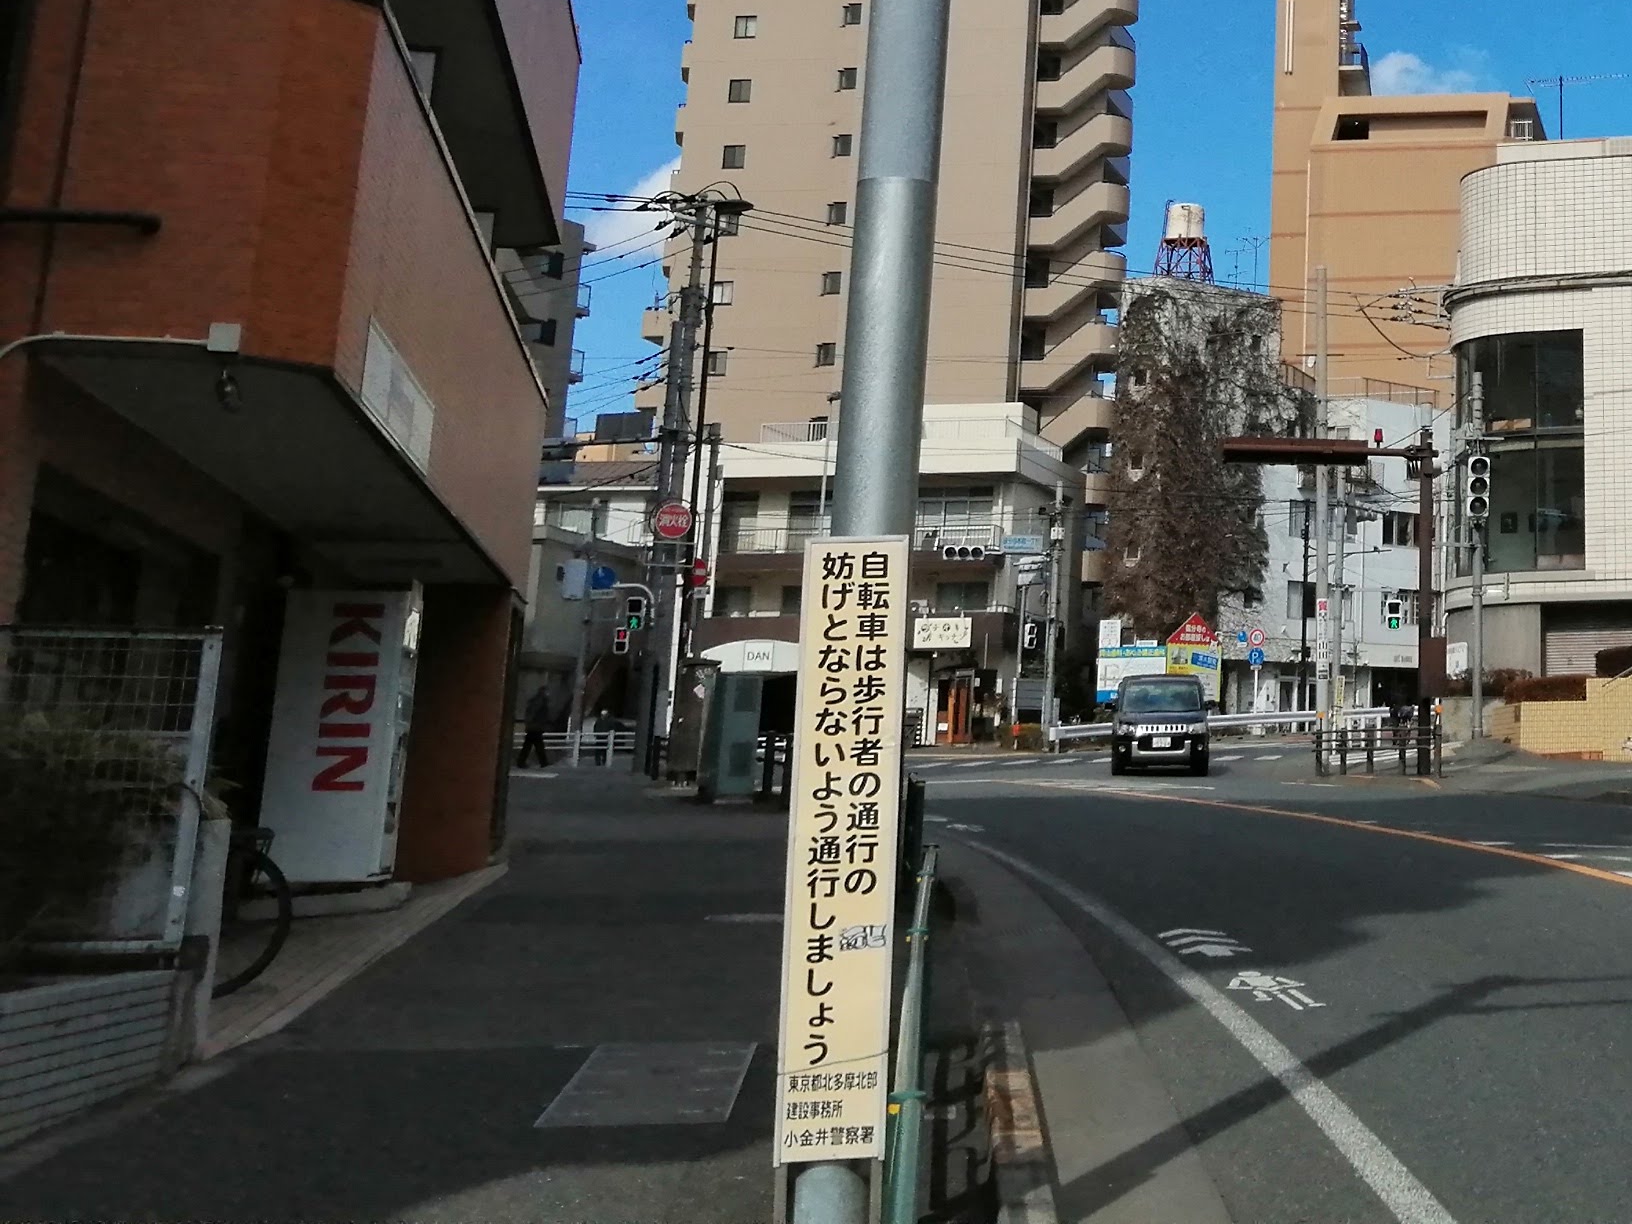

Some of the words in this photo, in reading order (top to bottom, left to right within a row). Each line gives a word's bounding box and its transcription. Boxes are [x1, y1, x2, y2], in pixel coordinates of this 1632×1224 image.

[658, 513, 689, 528] 消火栓
[746, 651, 770, 662] DAN
[312, 602, 386, 792] KIRIN
[844, 550, 890, 896] 自転車は歩行者の通行の
[803, 552, 856, 1066] 妨げとならないよう通行しましょう
[787, 1071, 878, 1093] 東京都北多摩北部
[785, 1099, 844, 1121] 建設事務所
[783, 1126, 875, 1148] 小金井警察署
